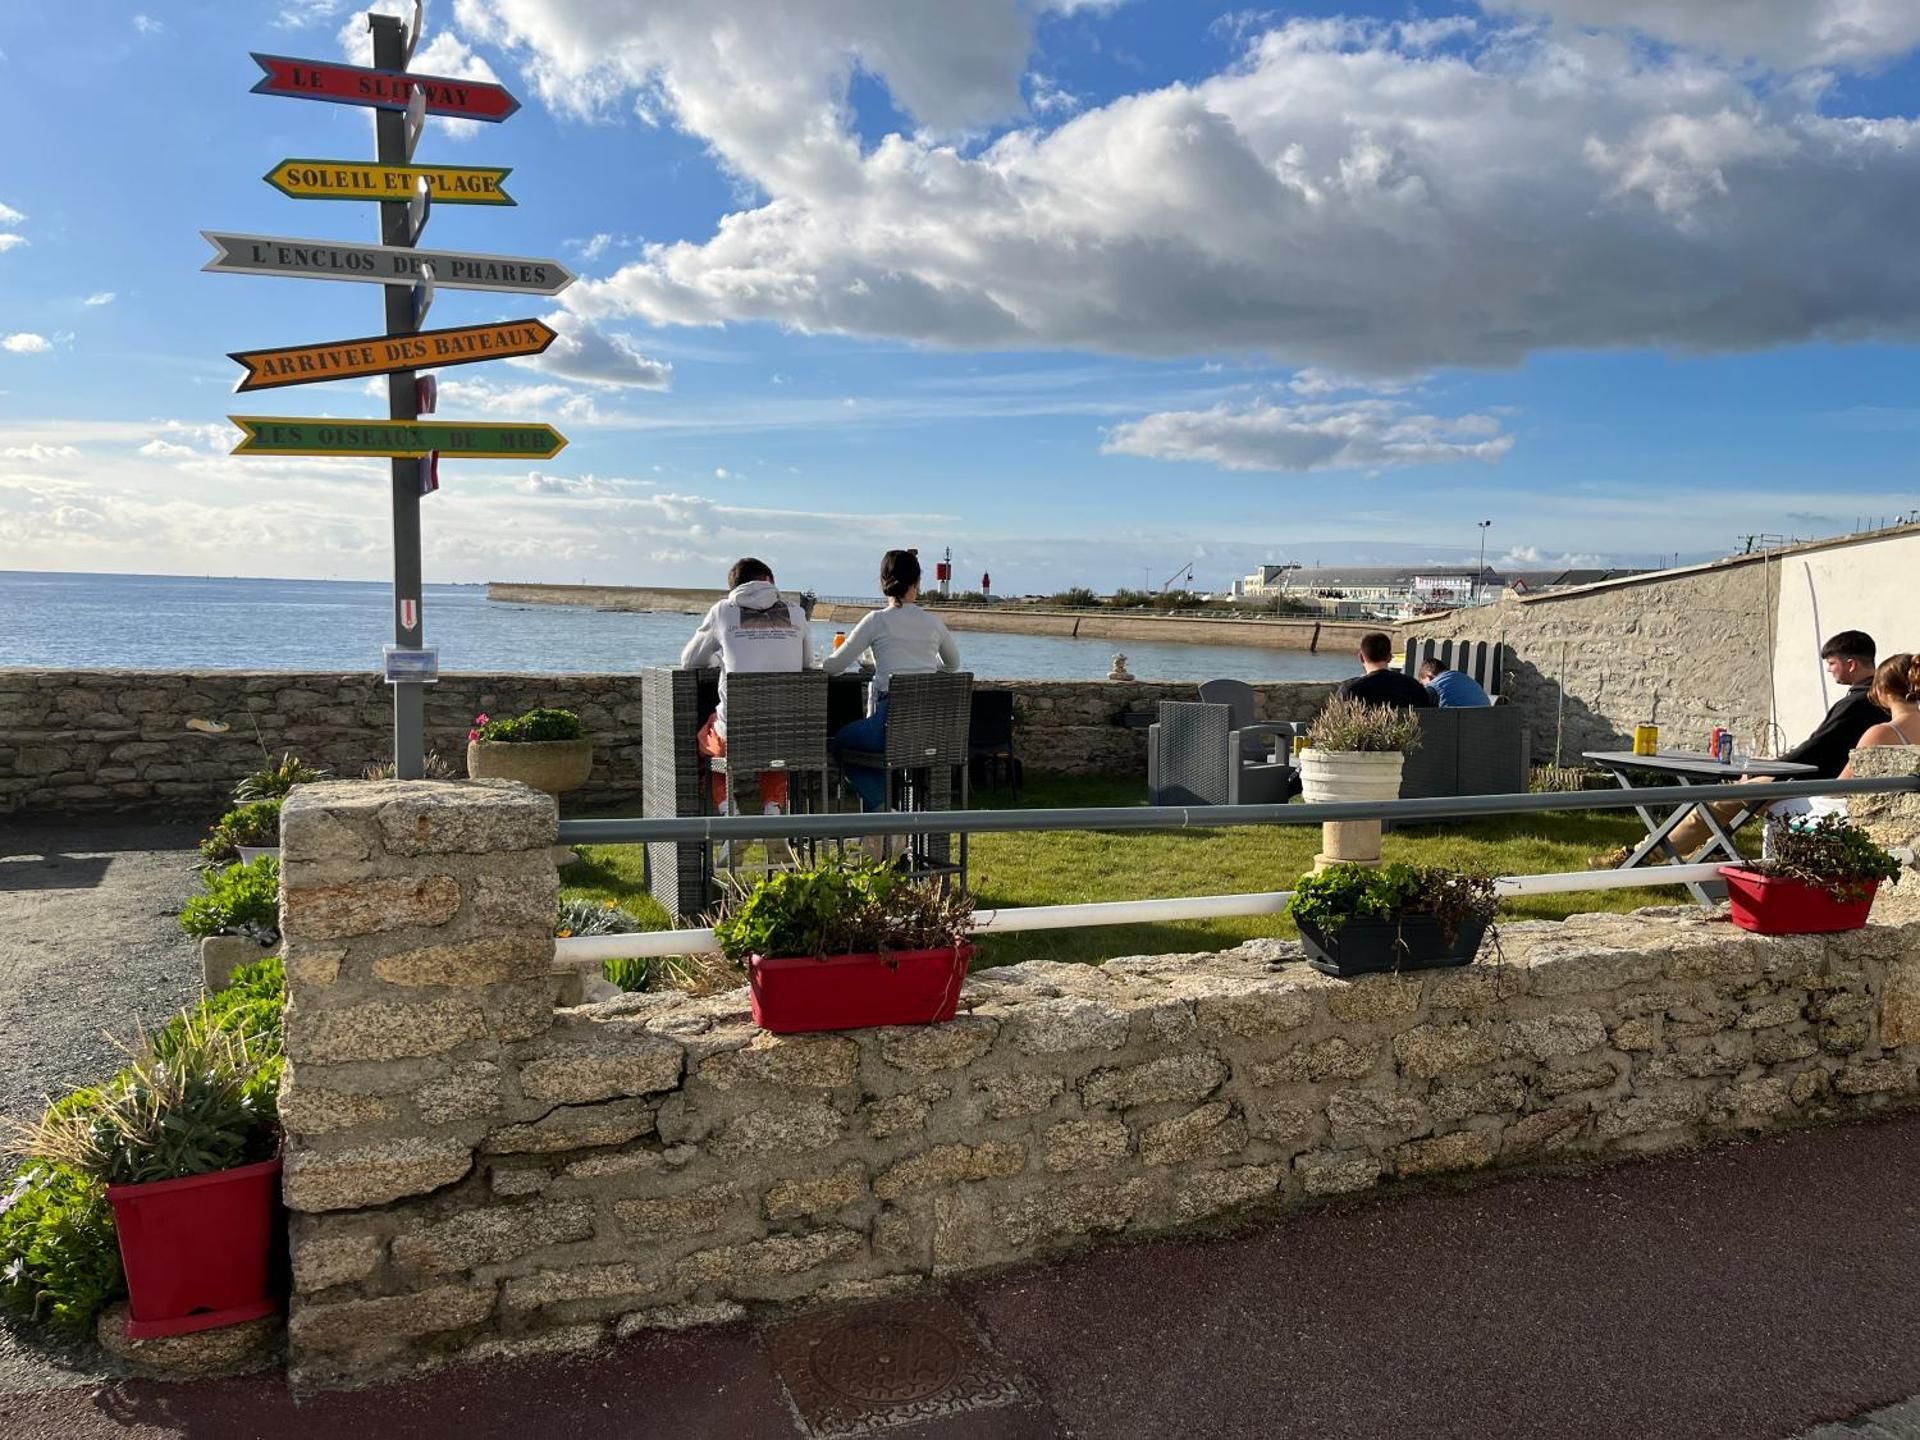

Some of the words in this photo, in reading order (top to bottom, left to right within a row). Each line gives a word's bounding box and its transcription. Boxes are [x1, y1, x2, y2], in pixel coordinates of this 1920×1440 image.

[293, 67, 323, 88] LE
[359, 77, 469, 105] SLIPWAY
[287, 168, 376, 189] SOLEIL
[384, 172, 411, 189] ET
[252, 242, 375, 271] L'ENCLOS
[393, 255, 436, 275] DES
[451, 261, 546, 284] PHARES
[262, 349, 375, 377] ARRIVEE
[385, 341, 427, 361] DES
[435, 327, 539, 355] BATEAUX
[255, 425, 302, 444] LES
[318, 425, 425, 447] OISEAUX
[449, 431, 476, 448] DE
[501, 431, 547, 449] MER
